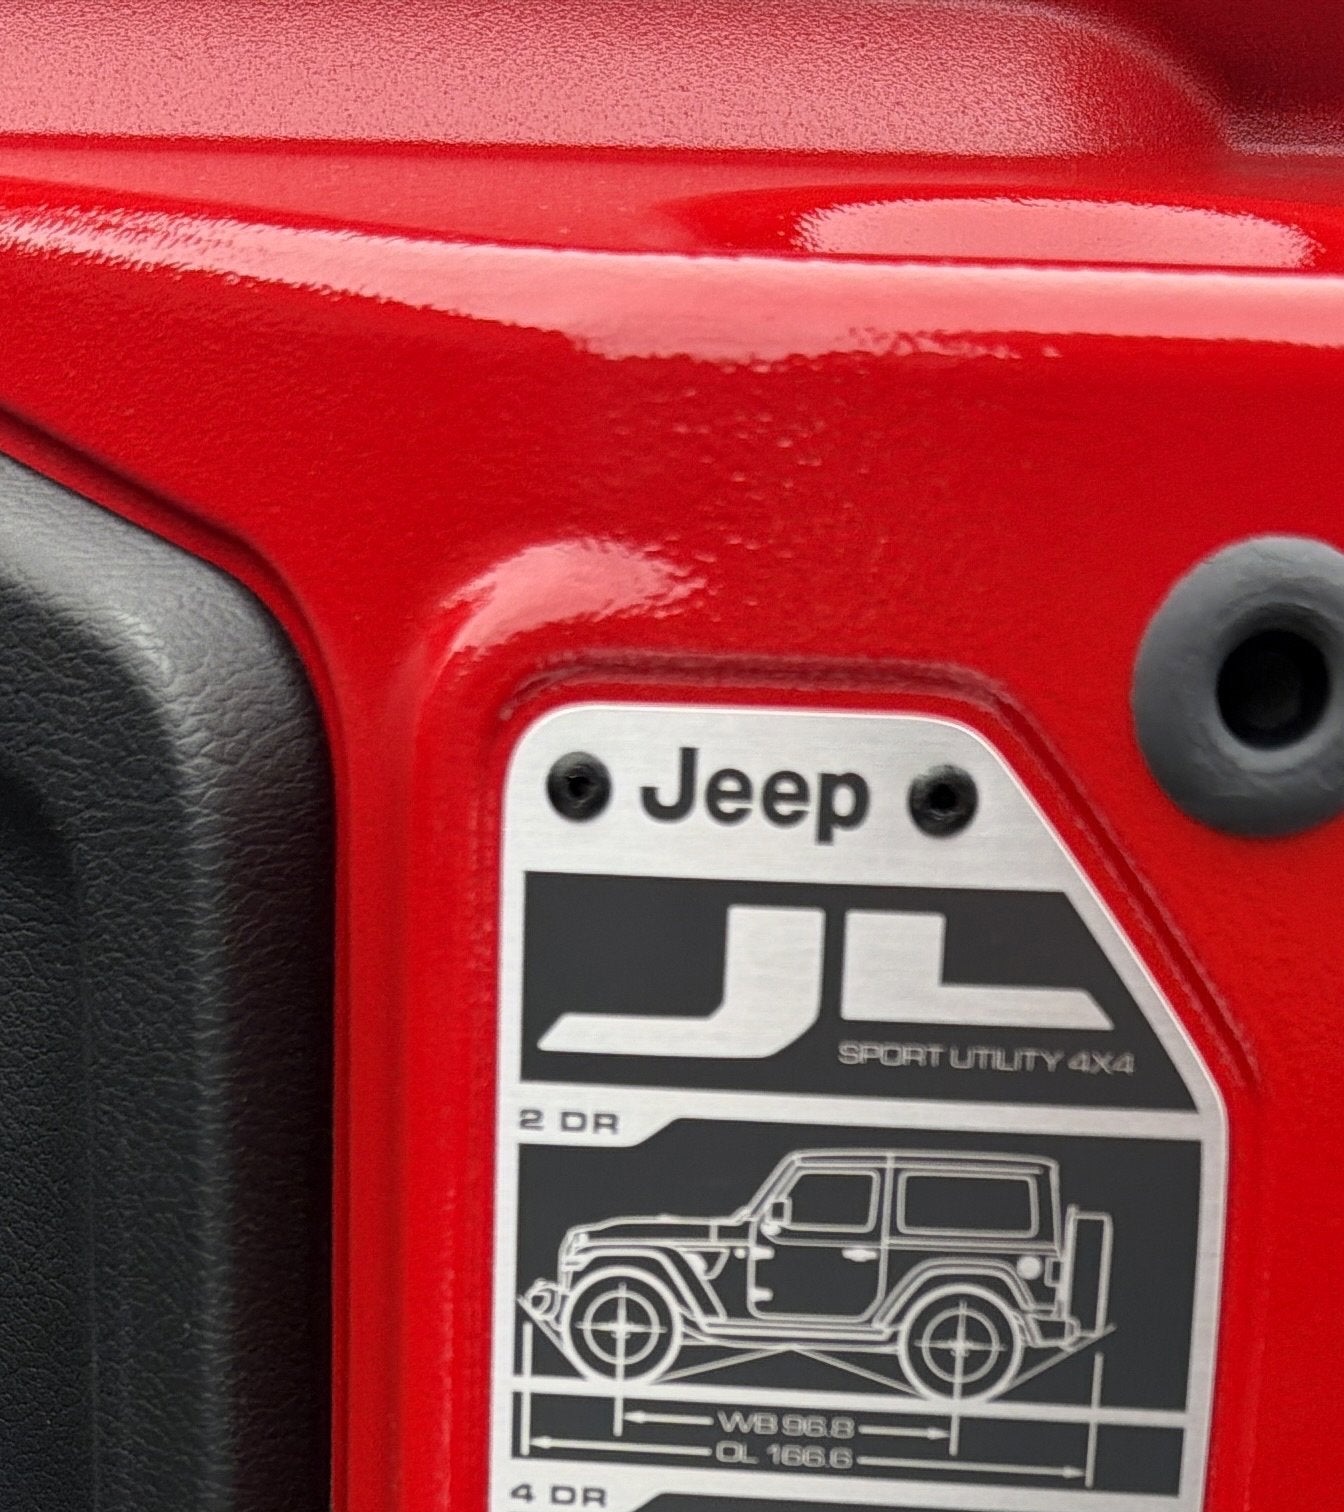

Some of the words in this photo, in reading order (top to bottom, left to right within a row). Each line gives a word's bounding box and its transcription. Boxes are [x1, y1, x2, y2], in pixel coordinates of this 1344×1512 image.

[640, 747, 871, 844] Jeep
[538, 905, 1114, 1060] JL
[838, 1042, 943, 1069] SPORT
[950, 1047, 1064, 1074] UTILITY
[1068, 1051, 1136, 1076] 4X4
[519, 1109, 543, 1132] 2
[560, 1111, 619, 1135] DR
[718, 1410, 778, 1435] WB
[782, 1413, 855, 1439] 96.8
[716, 1440, 759, 1464] OL
[767, 1443, 853, 1469] 166.6
[511, 1484, 533, 1503] 4
[551, 1486, 607, 1507] DR
